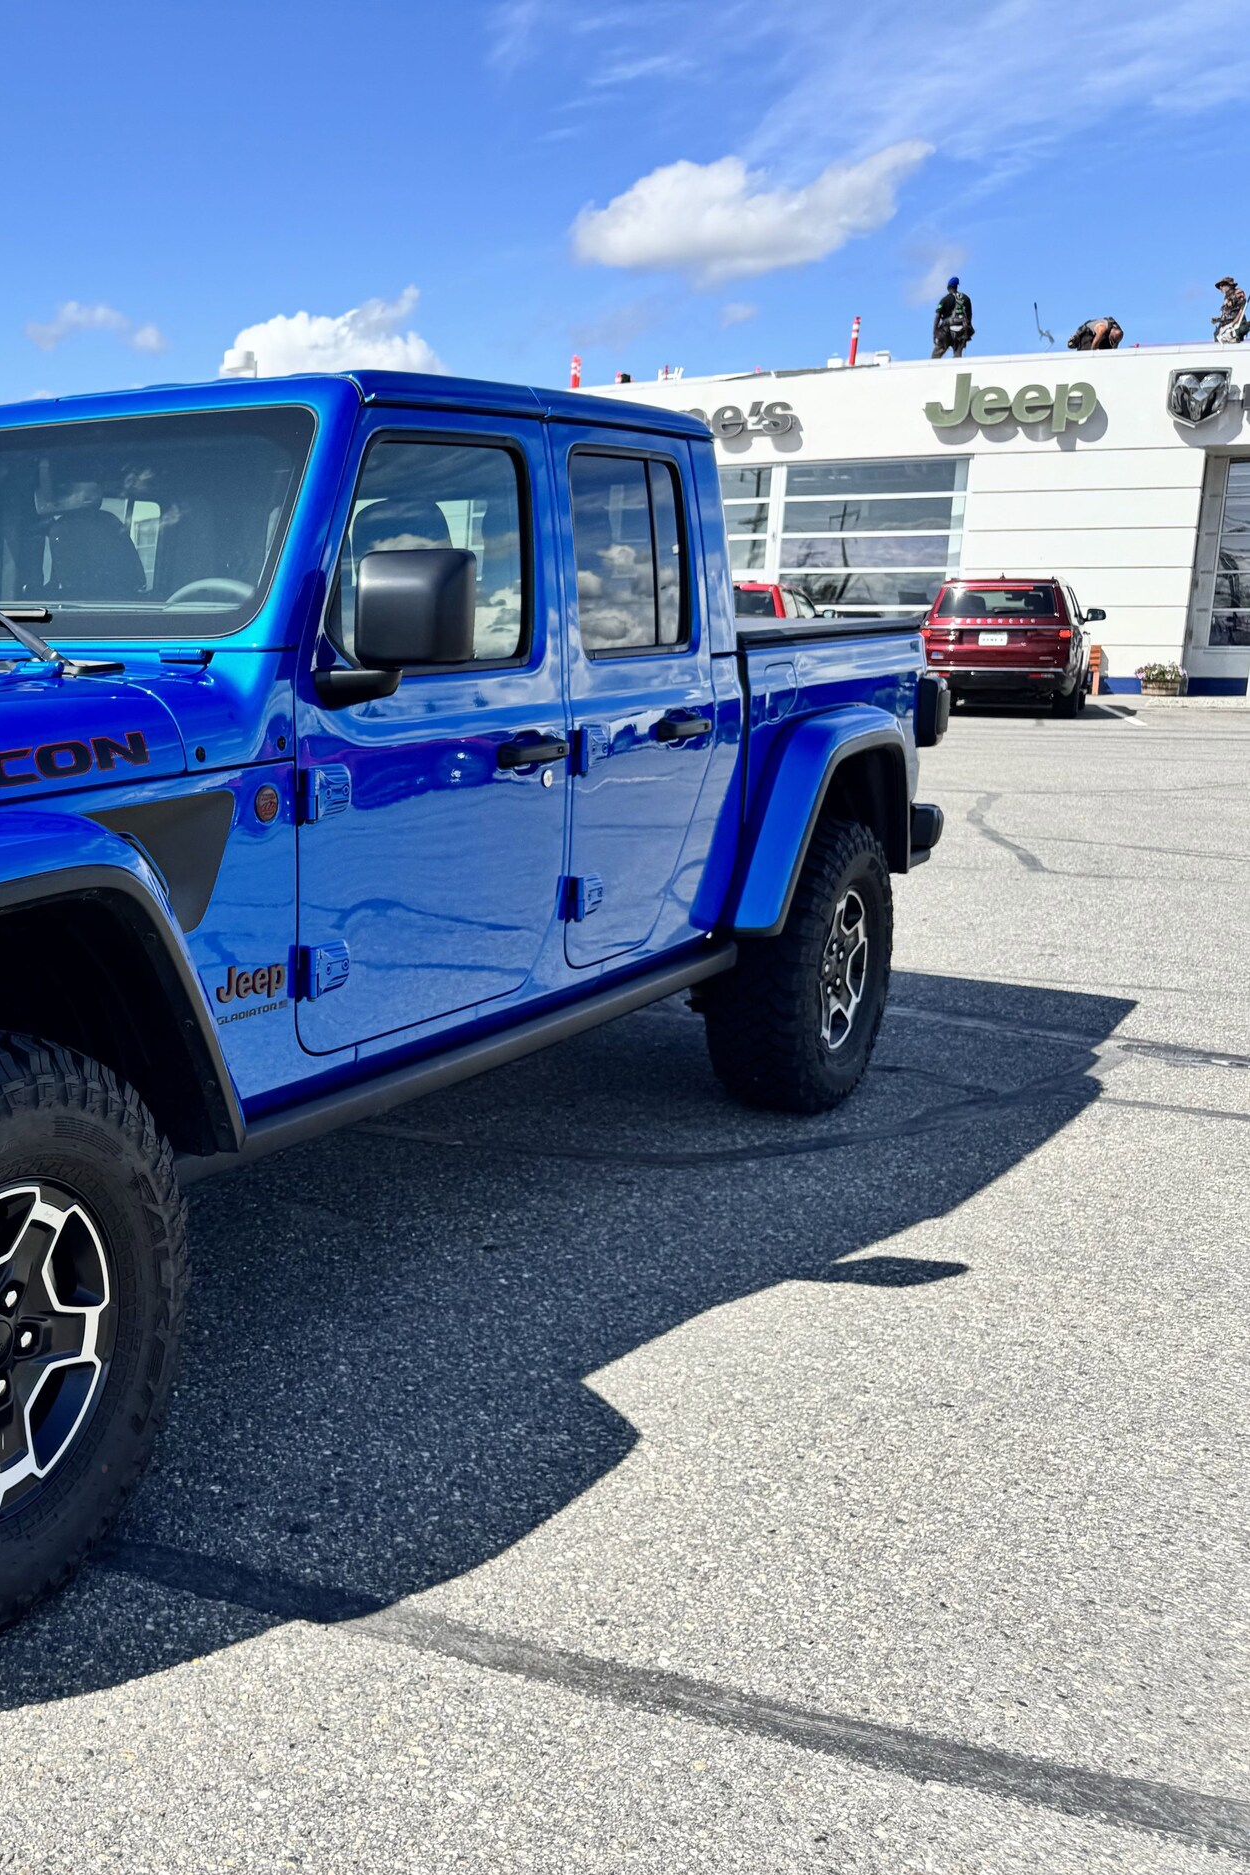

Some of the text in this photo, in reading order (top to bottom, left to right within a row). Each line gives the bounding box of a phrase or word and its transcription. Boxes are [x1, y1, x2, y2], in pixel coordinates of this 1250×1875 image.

[679, 401, 794, 438] e's
[922, 373, 1097, 433] Jeep
[216, 963, 286, 1003] Jeep
[216, 1002, 278, 1025] GLADIATOR
